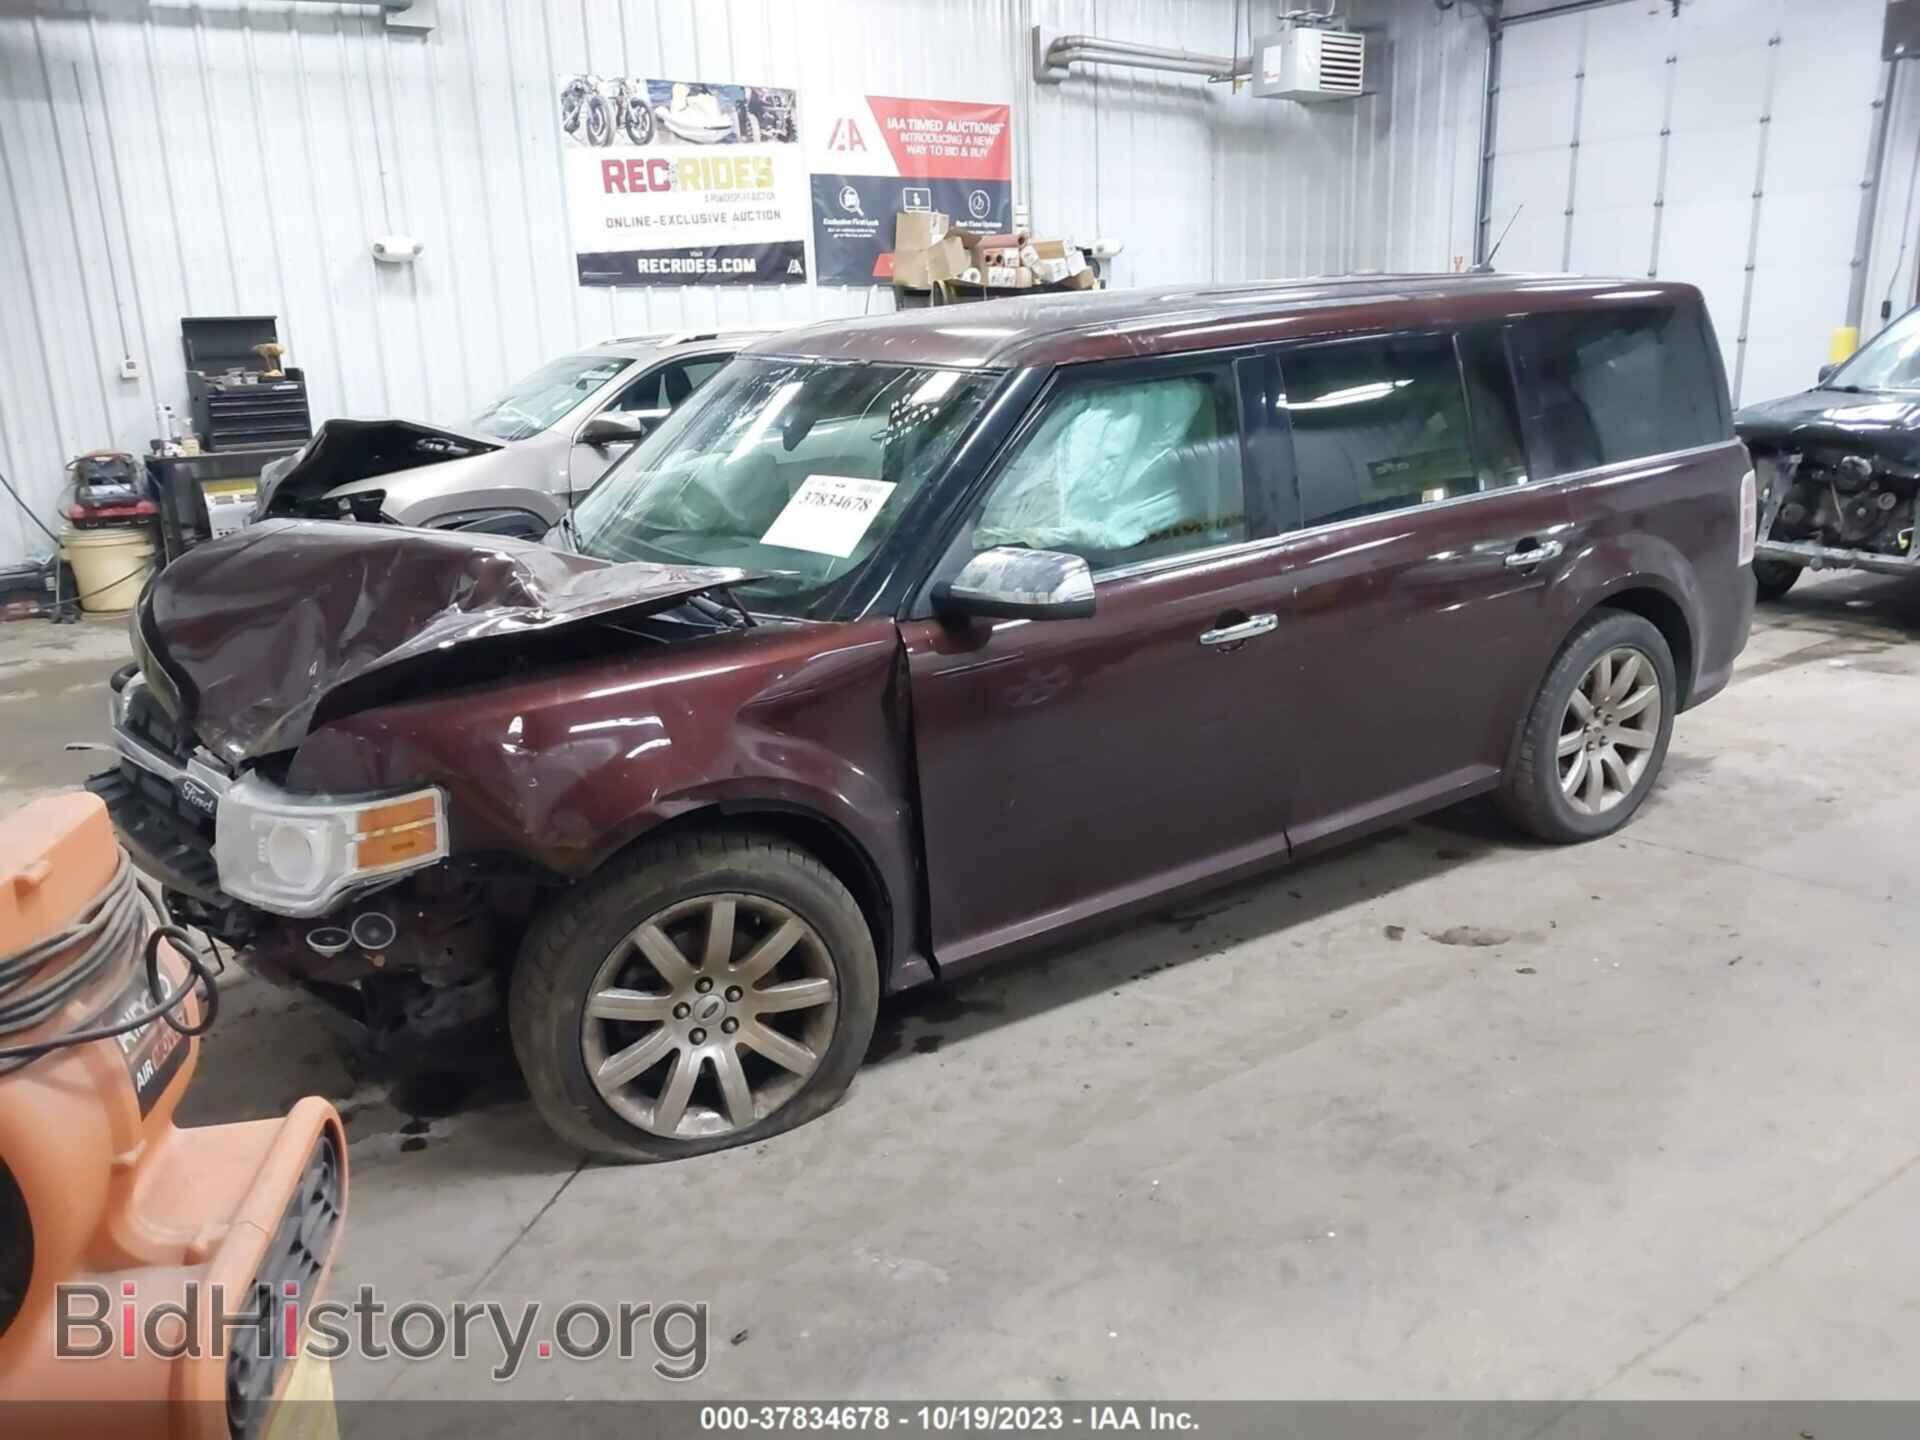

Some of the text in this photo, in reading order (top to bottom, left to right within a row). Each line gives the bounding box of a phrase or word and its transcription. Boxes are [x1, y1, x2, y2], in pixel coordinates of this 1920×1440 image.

[887, 117, 907, 130] IAA
[907, 118, 943, 131] TIMED
[900, 132, 995, 147] INTRODUCING A NEW
[905, 144, 928, 156] WAY
[930, 145, 944, 156] TO
[601, 158, 671, 194] REC
[677, 156, 775, 192] RIDES
[606, 209, 782, 229] ONLINE-EXCLUSIVE AUCTION
[637, 258, 757, 274] RECRIDES.COM
[799, 491, 873, 512] 37834678
[182, 780, 214, 814] Ford
[136, 1059, 154, 1093] AIR
